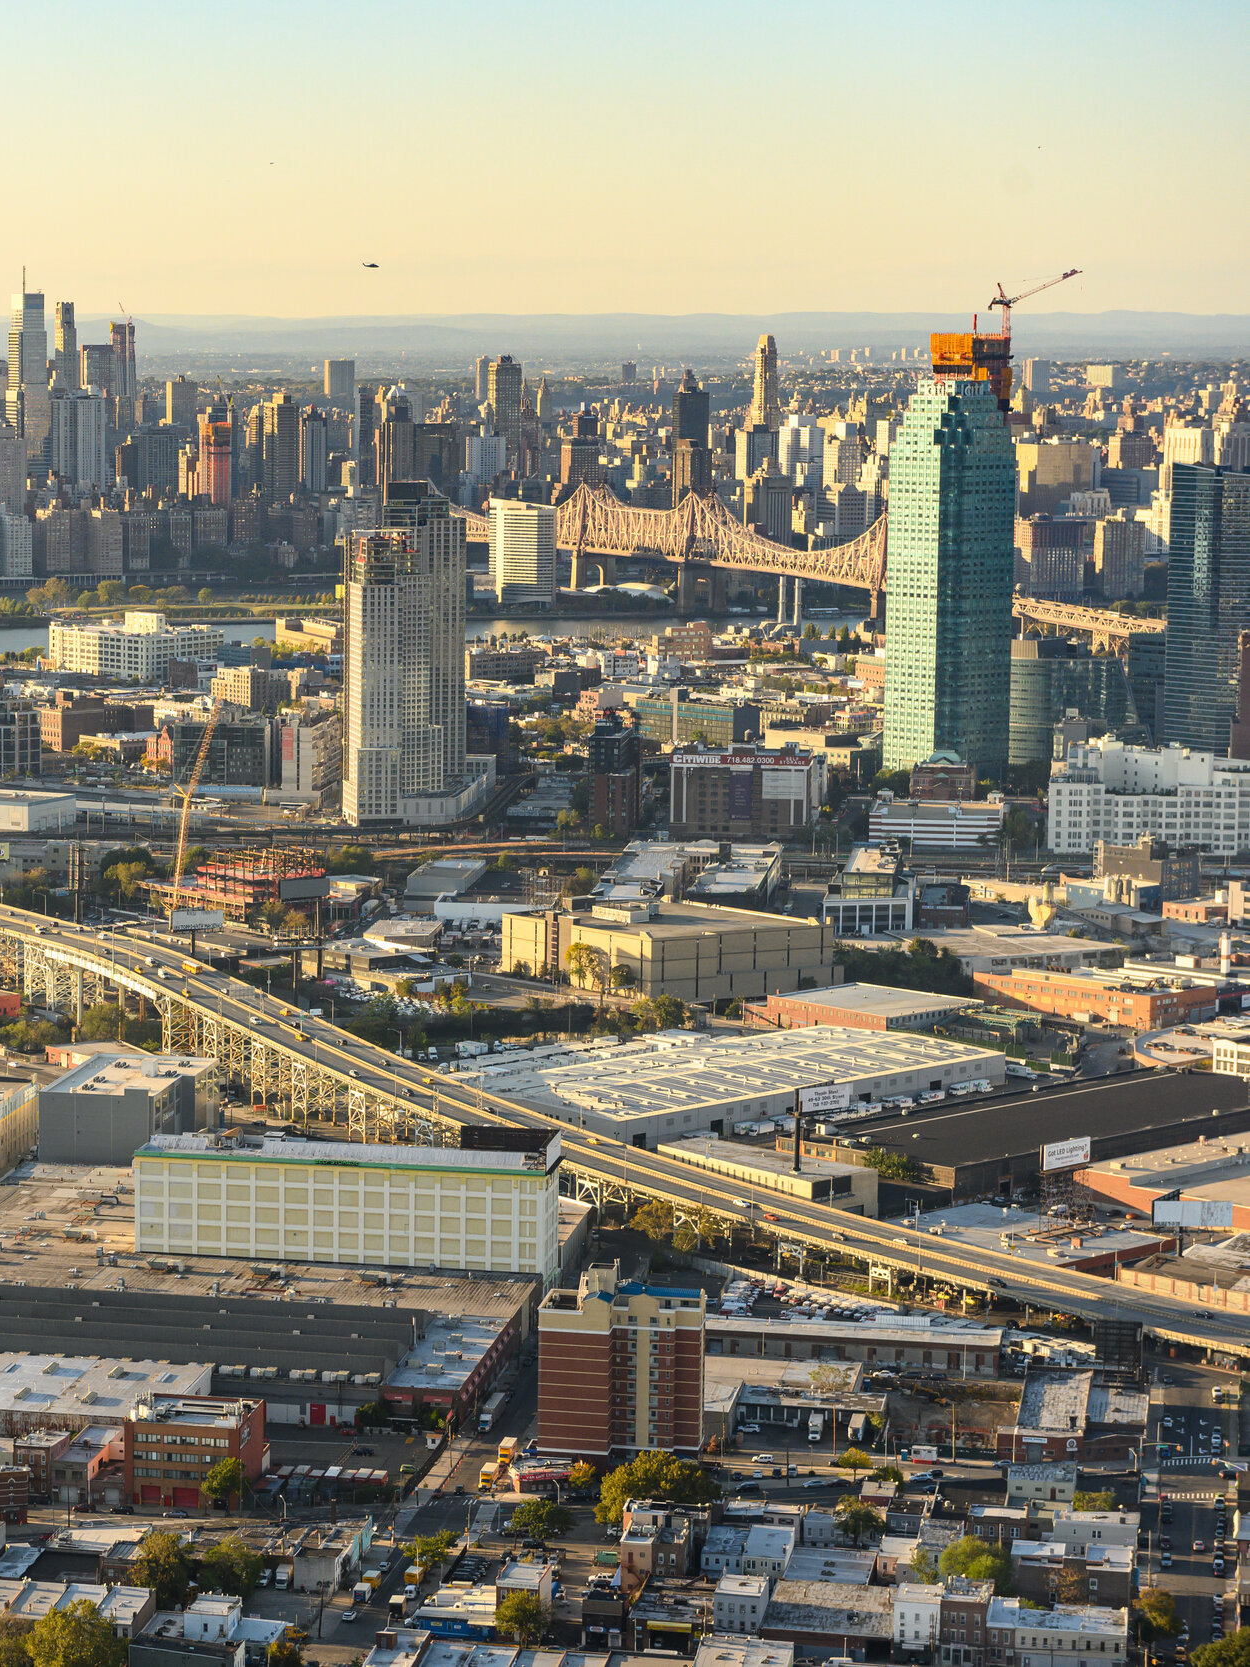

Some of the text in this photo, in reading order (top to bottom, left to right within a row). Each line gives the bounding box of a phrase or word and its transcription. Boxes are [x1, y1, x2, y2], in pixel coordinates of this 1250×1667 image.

[928, 381, 945, 396] citi
[964, 382, 984, 396] citi
[1066, 1144, 1087, 1154] Lighting?
